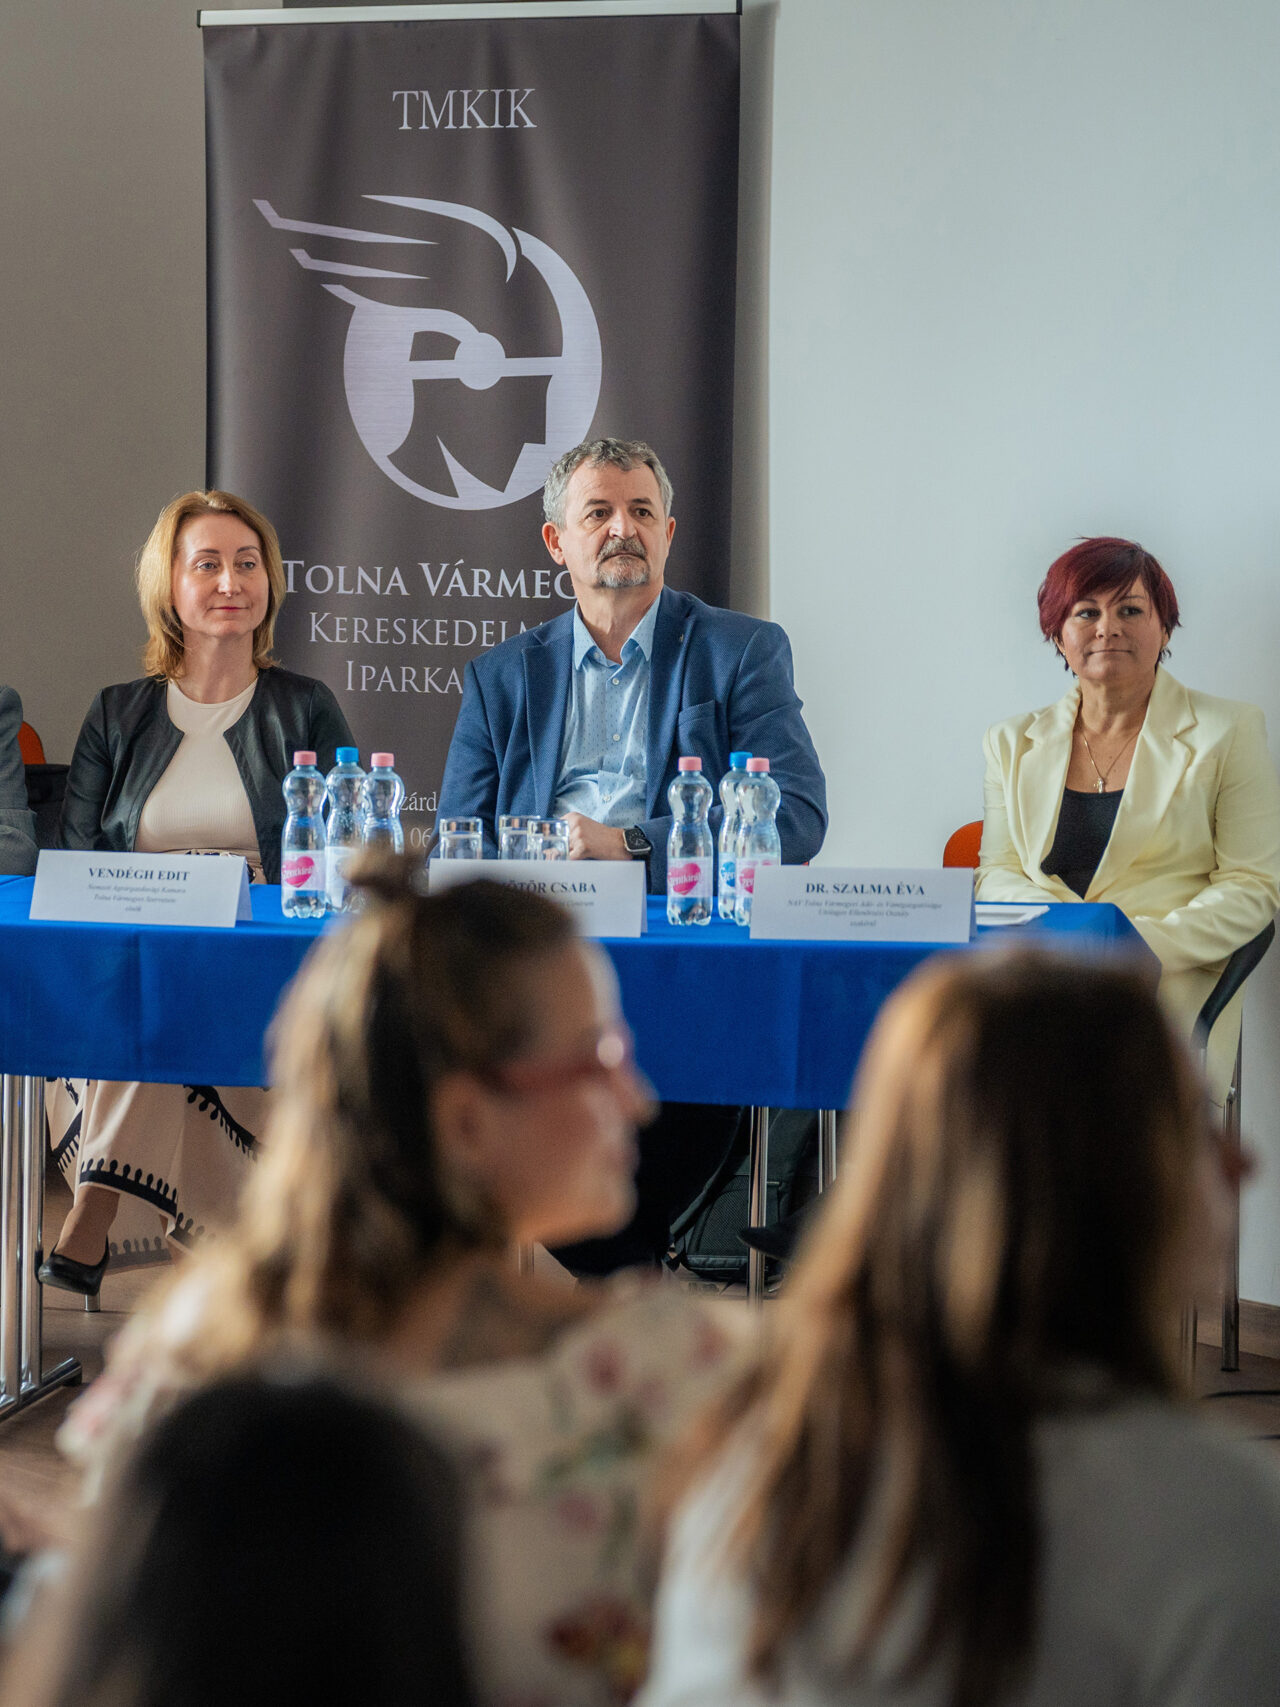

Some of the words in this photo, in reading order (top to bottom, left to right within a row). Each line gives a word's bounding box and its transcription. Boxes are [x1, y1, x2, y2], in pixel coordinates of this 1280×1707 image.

[392, 88, 538, 131] TMKIK
[281, 559, 411, 596] TOLNA
[417, 558, 578, 600] VÁRMEG
[309, 611, 544, 647] KERESKEDEL
[344, 660, 464, 694] IPARKA
[88, 866, 154, 881] VENDÉGH
[158, 869, 191, 881] EDIT
[551, 881, 597, 894] CSABA
[806, 882, 829, 894] DR.
[832, 882, 892, 895] SZALMA
[896, 881, 925, 896] ÉVA
